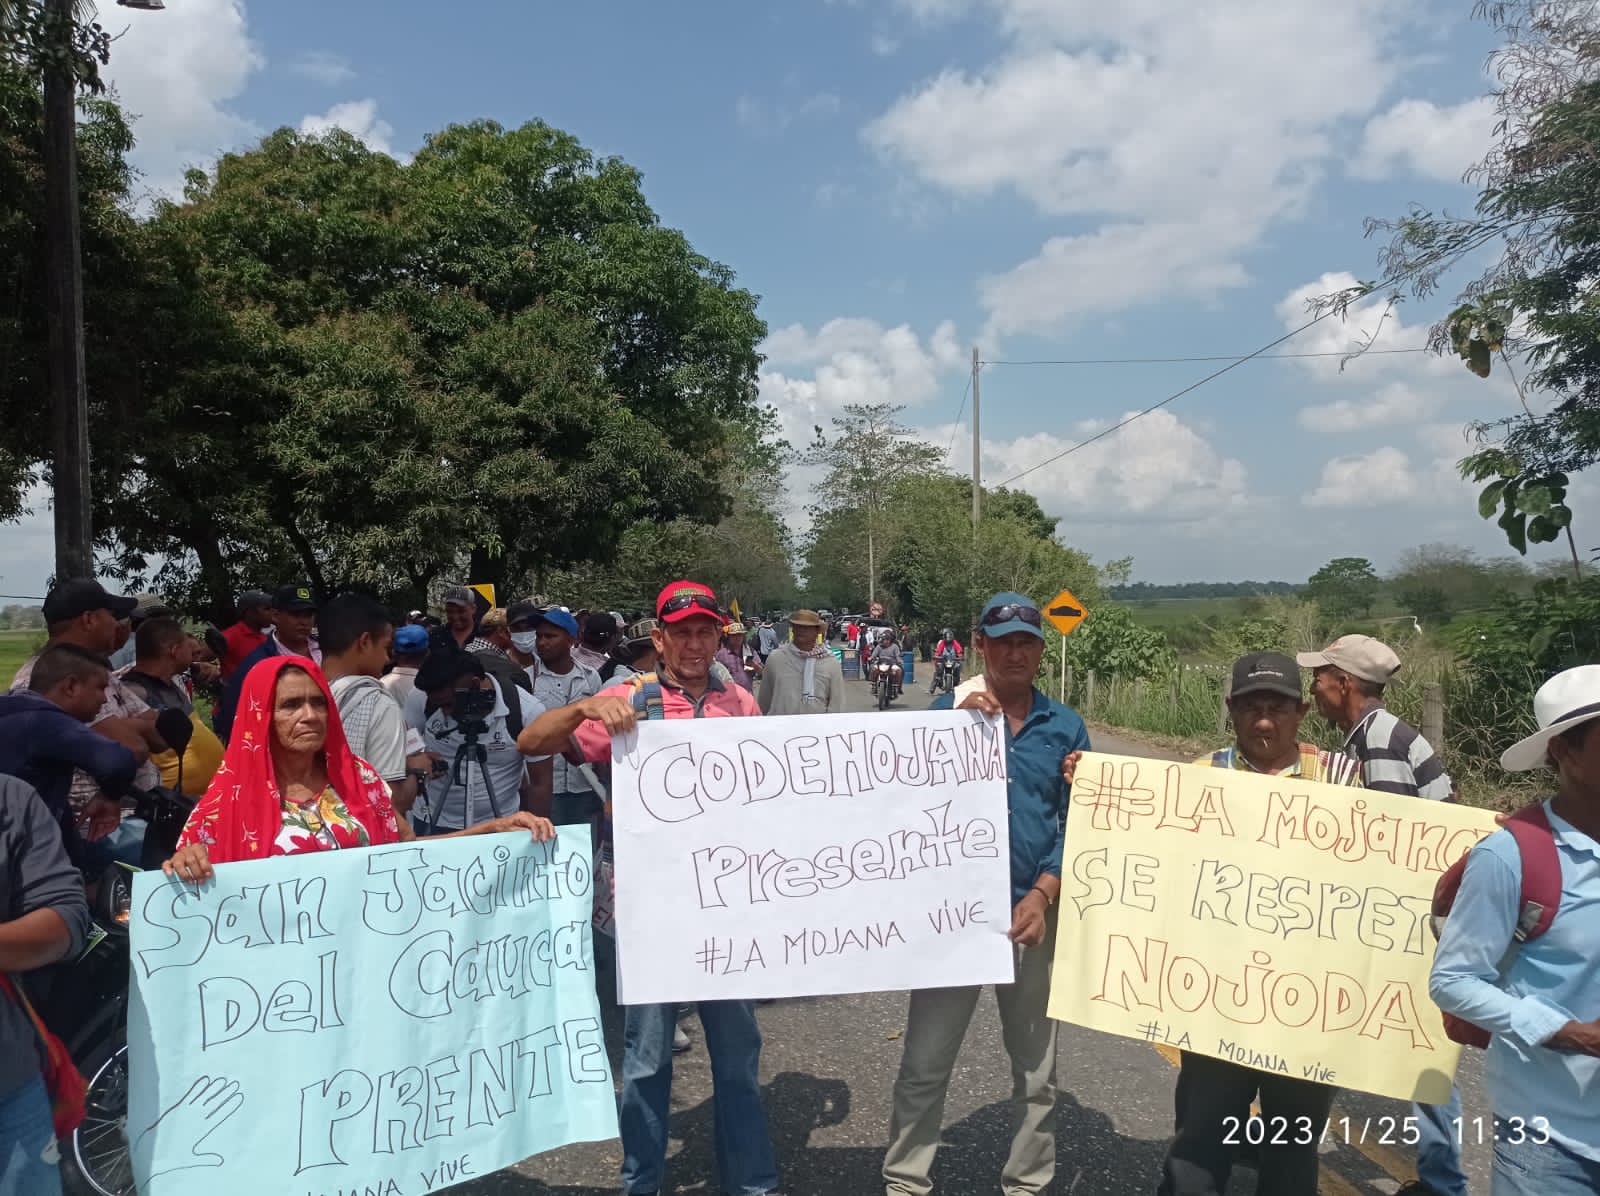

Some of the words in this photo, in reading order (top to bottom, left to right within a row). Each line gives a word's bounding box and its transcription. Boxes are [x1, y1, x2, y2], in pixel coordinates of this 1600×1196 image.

[1072, 761, 1235, 838] #LA
[138, 876, 335, 979] San
[362, 834, 591, 937] Jacinto
[1071, 847, 1161, 921] SE
[198, 951, 345, 1052] Del
[388, 921, 588, 1020] Cauca
[695, 936, 767, 975] #LA
[783, 921, 906, 966] MOJANA
[1136, 1020, 1193, 1050] #LA
[1217, 1038, 1289, 1074] MOJANA
[293, 1017, 607, 1176] PRENTE
